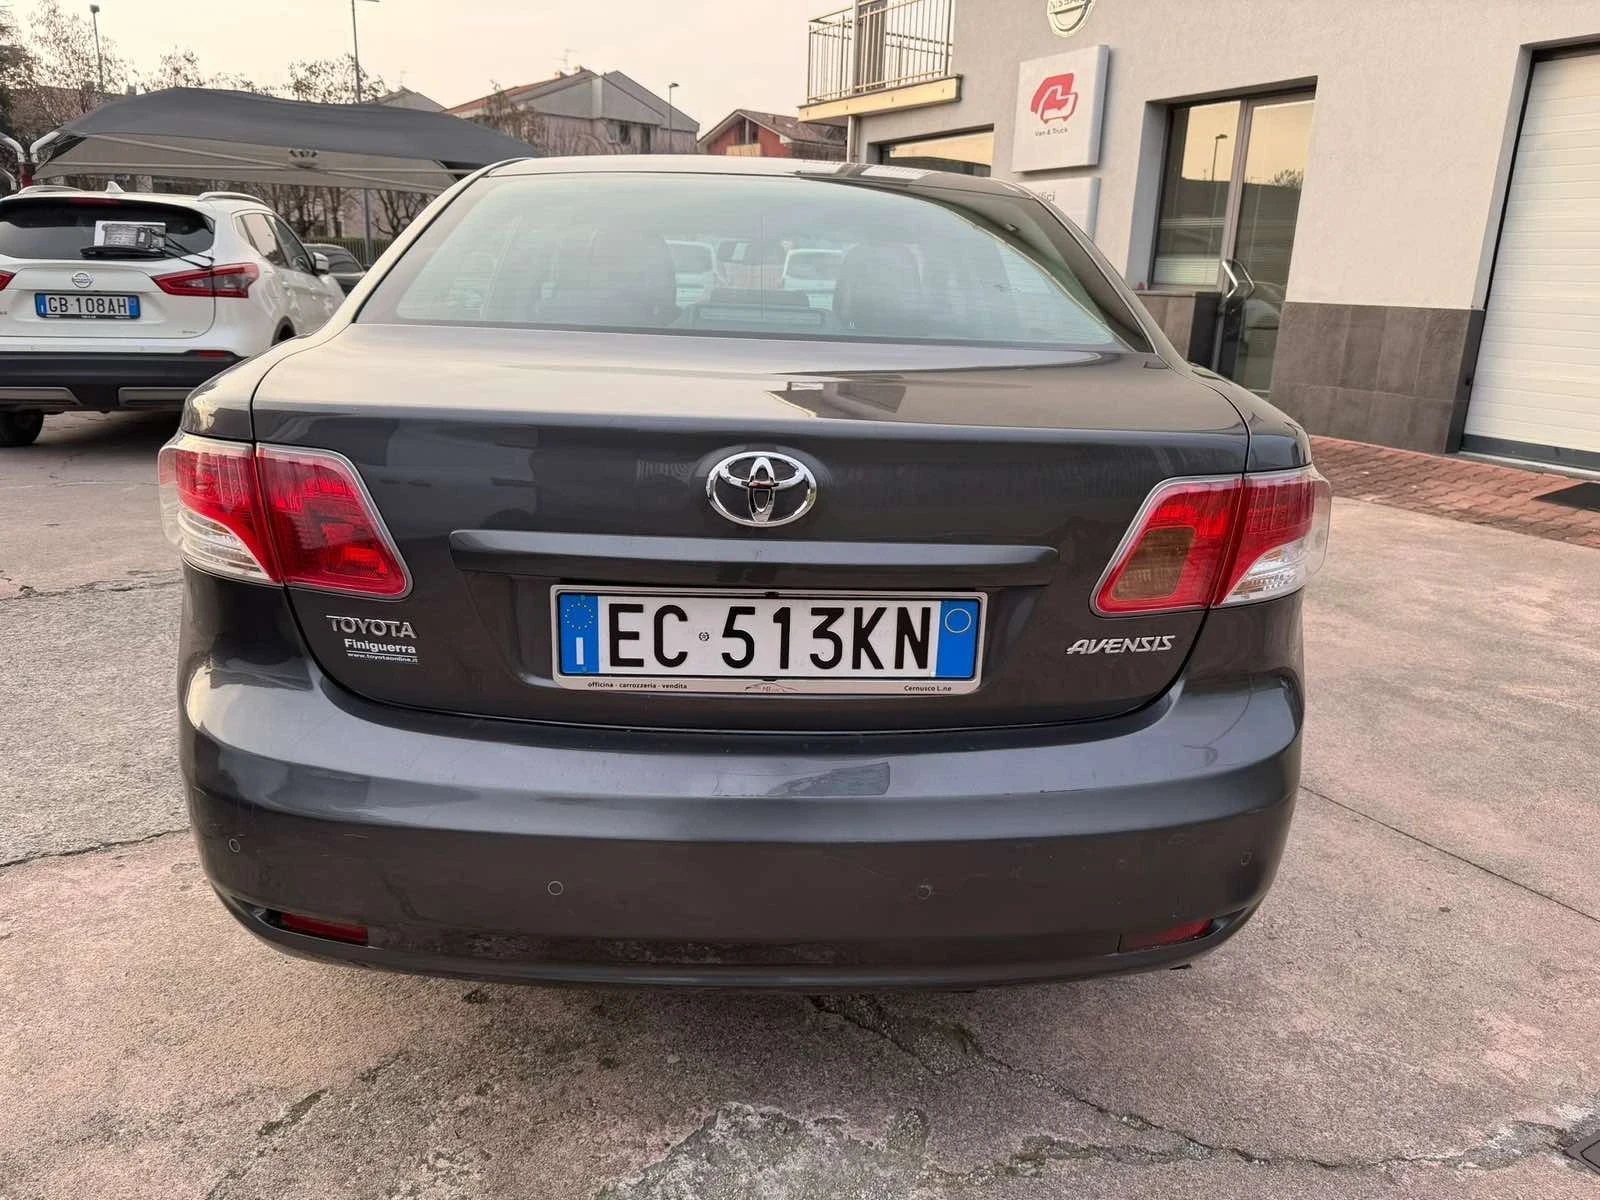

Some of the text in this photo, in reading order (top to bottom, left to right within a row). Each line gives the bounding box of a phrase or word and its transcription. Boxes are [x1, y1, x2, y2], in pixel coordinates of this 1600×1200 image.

[48, 297, 127, 314] GB 108AH
[326, 615, 417, 639] TOYOTA
[608, 603, 932, 670] EC 513KN
[344, 638, 417, 654] Finiguerra
[1066, 635, 1176, 654] AVENSIS
